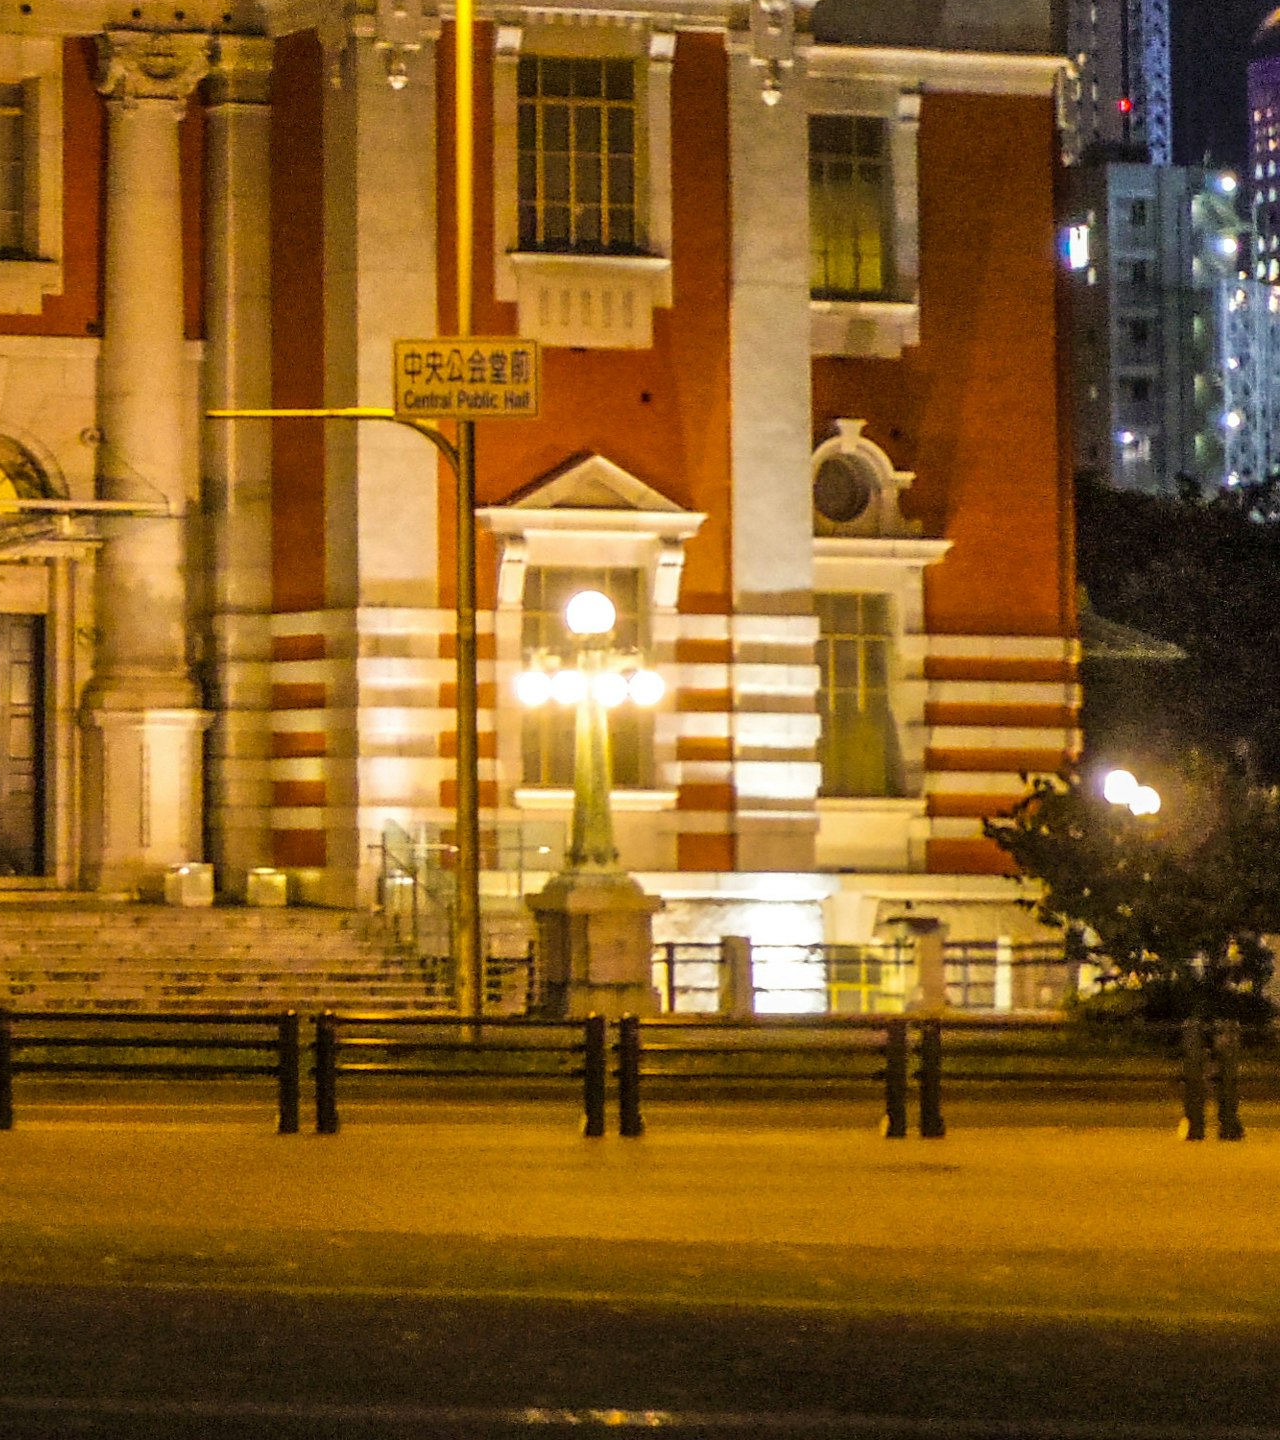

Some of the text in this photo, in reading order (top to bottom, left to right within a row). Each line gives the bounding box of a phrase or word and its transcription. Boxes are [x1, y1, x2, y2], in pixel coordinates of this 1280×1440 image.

[403, 348, 530, 384] 中央公会堂前
[404, 390, 530, 409] Central Public Hall
